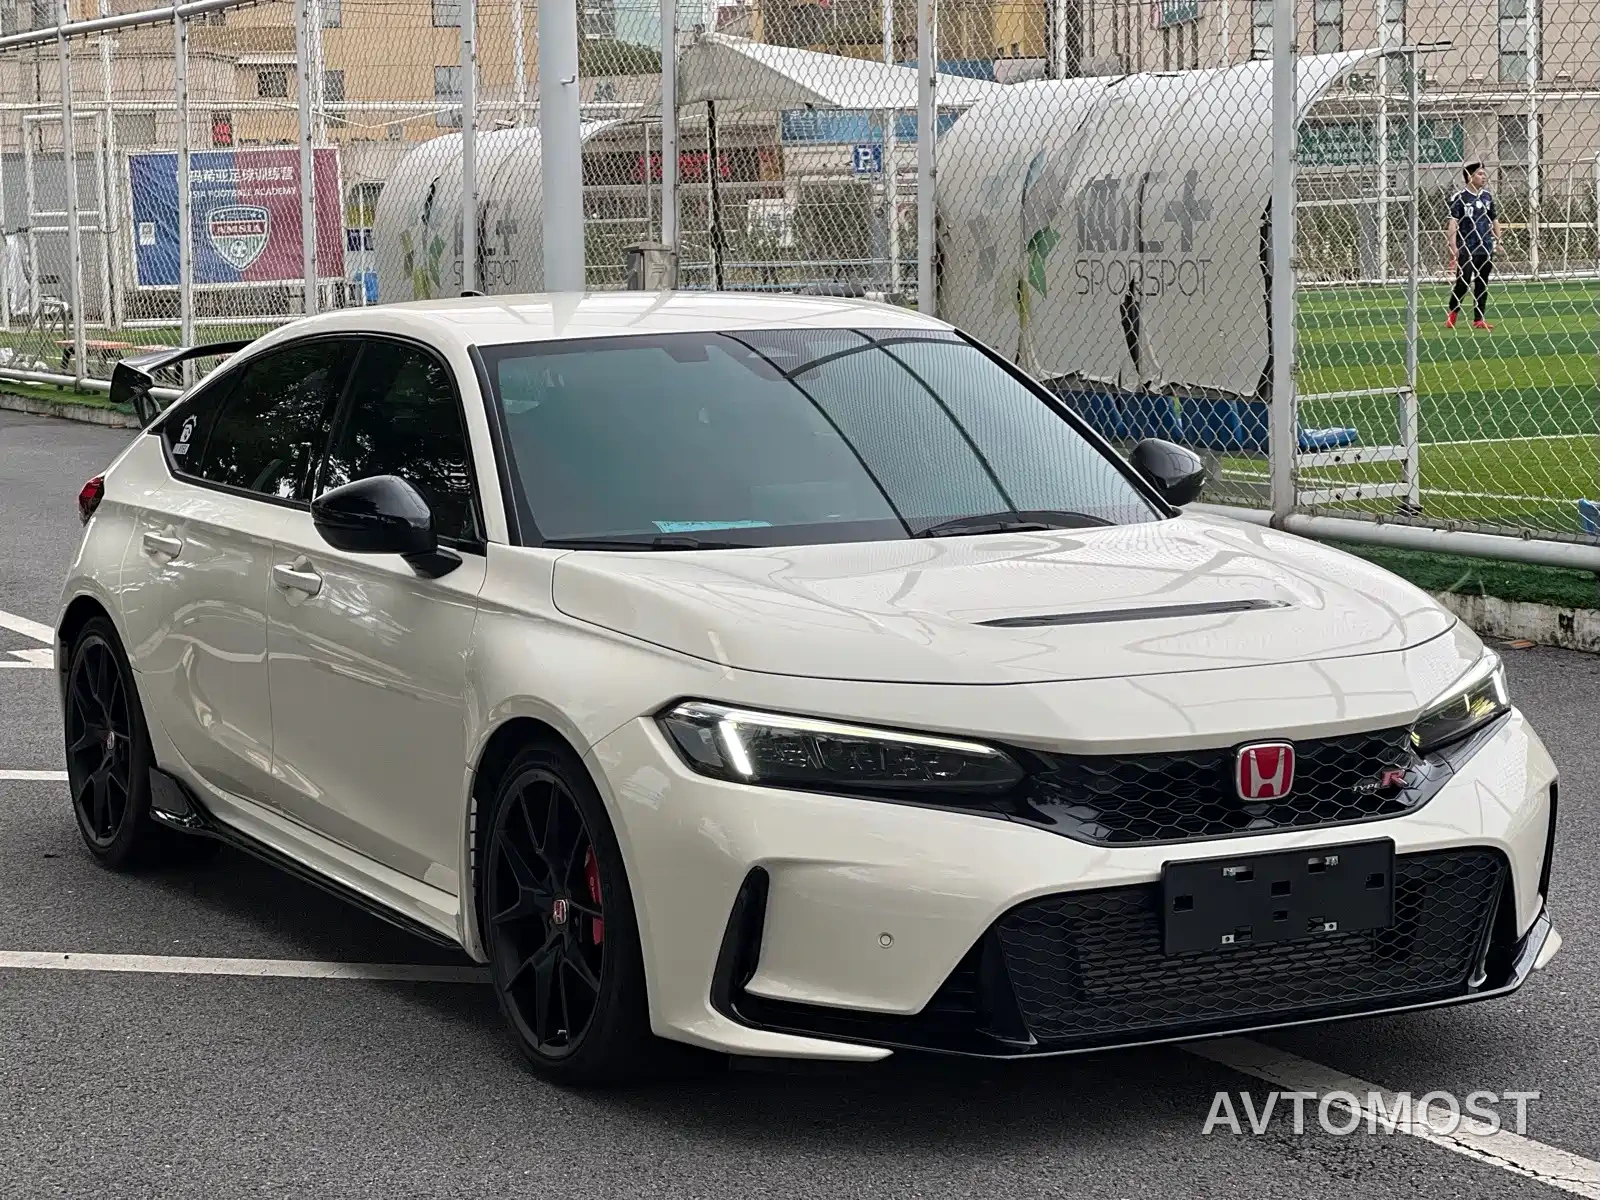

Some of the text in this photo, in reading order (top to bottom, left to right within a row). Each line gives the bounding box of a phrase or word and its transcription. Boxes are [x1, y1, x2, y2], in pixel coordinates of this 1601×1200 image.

[176, 166, 294, 183] 玛希亚足球训练营
[254, 186, 296, 196] ACADEMY
[1381, 769, 1407, 788] R
